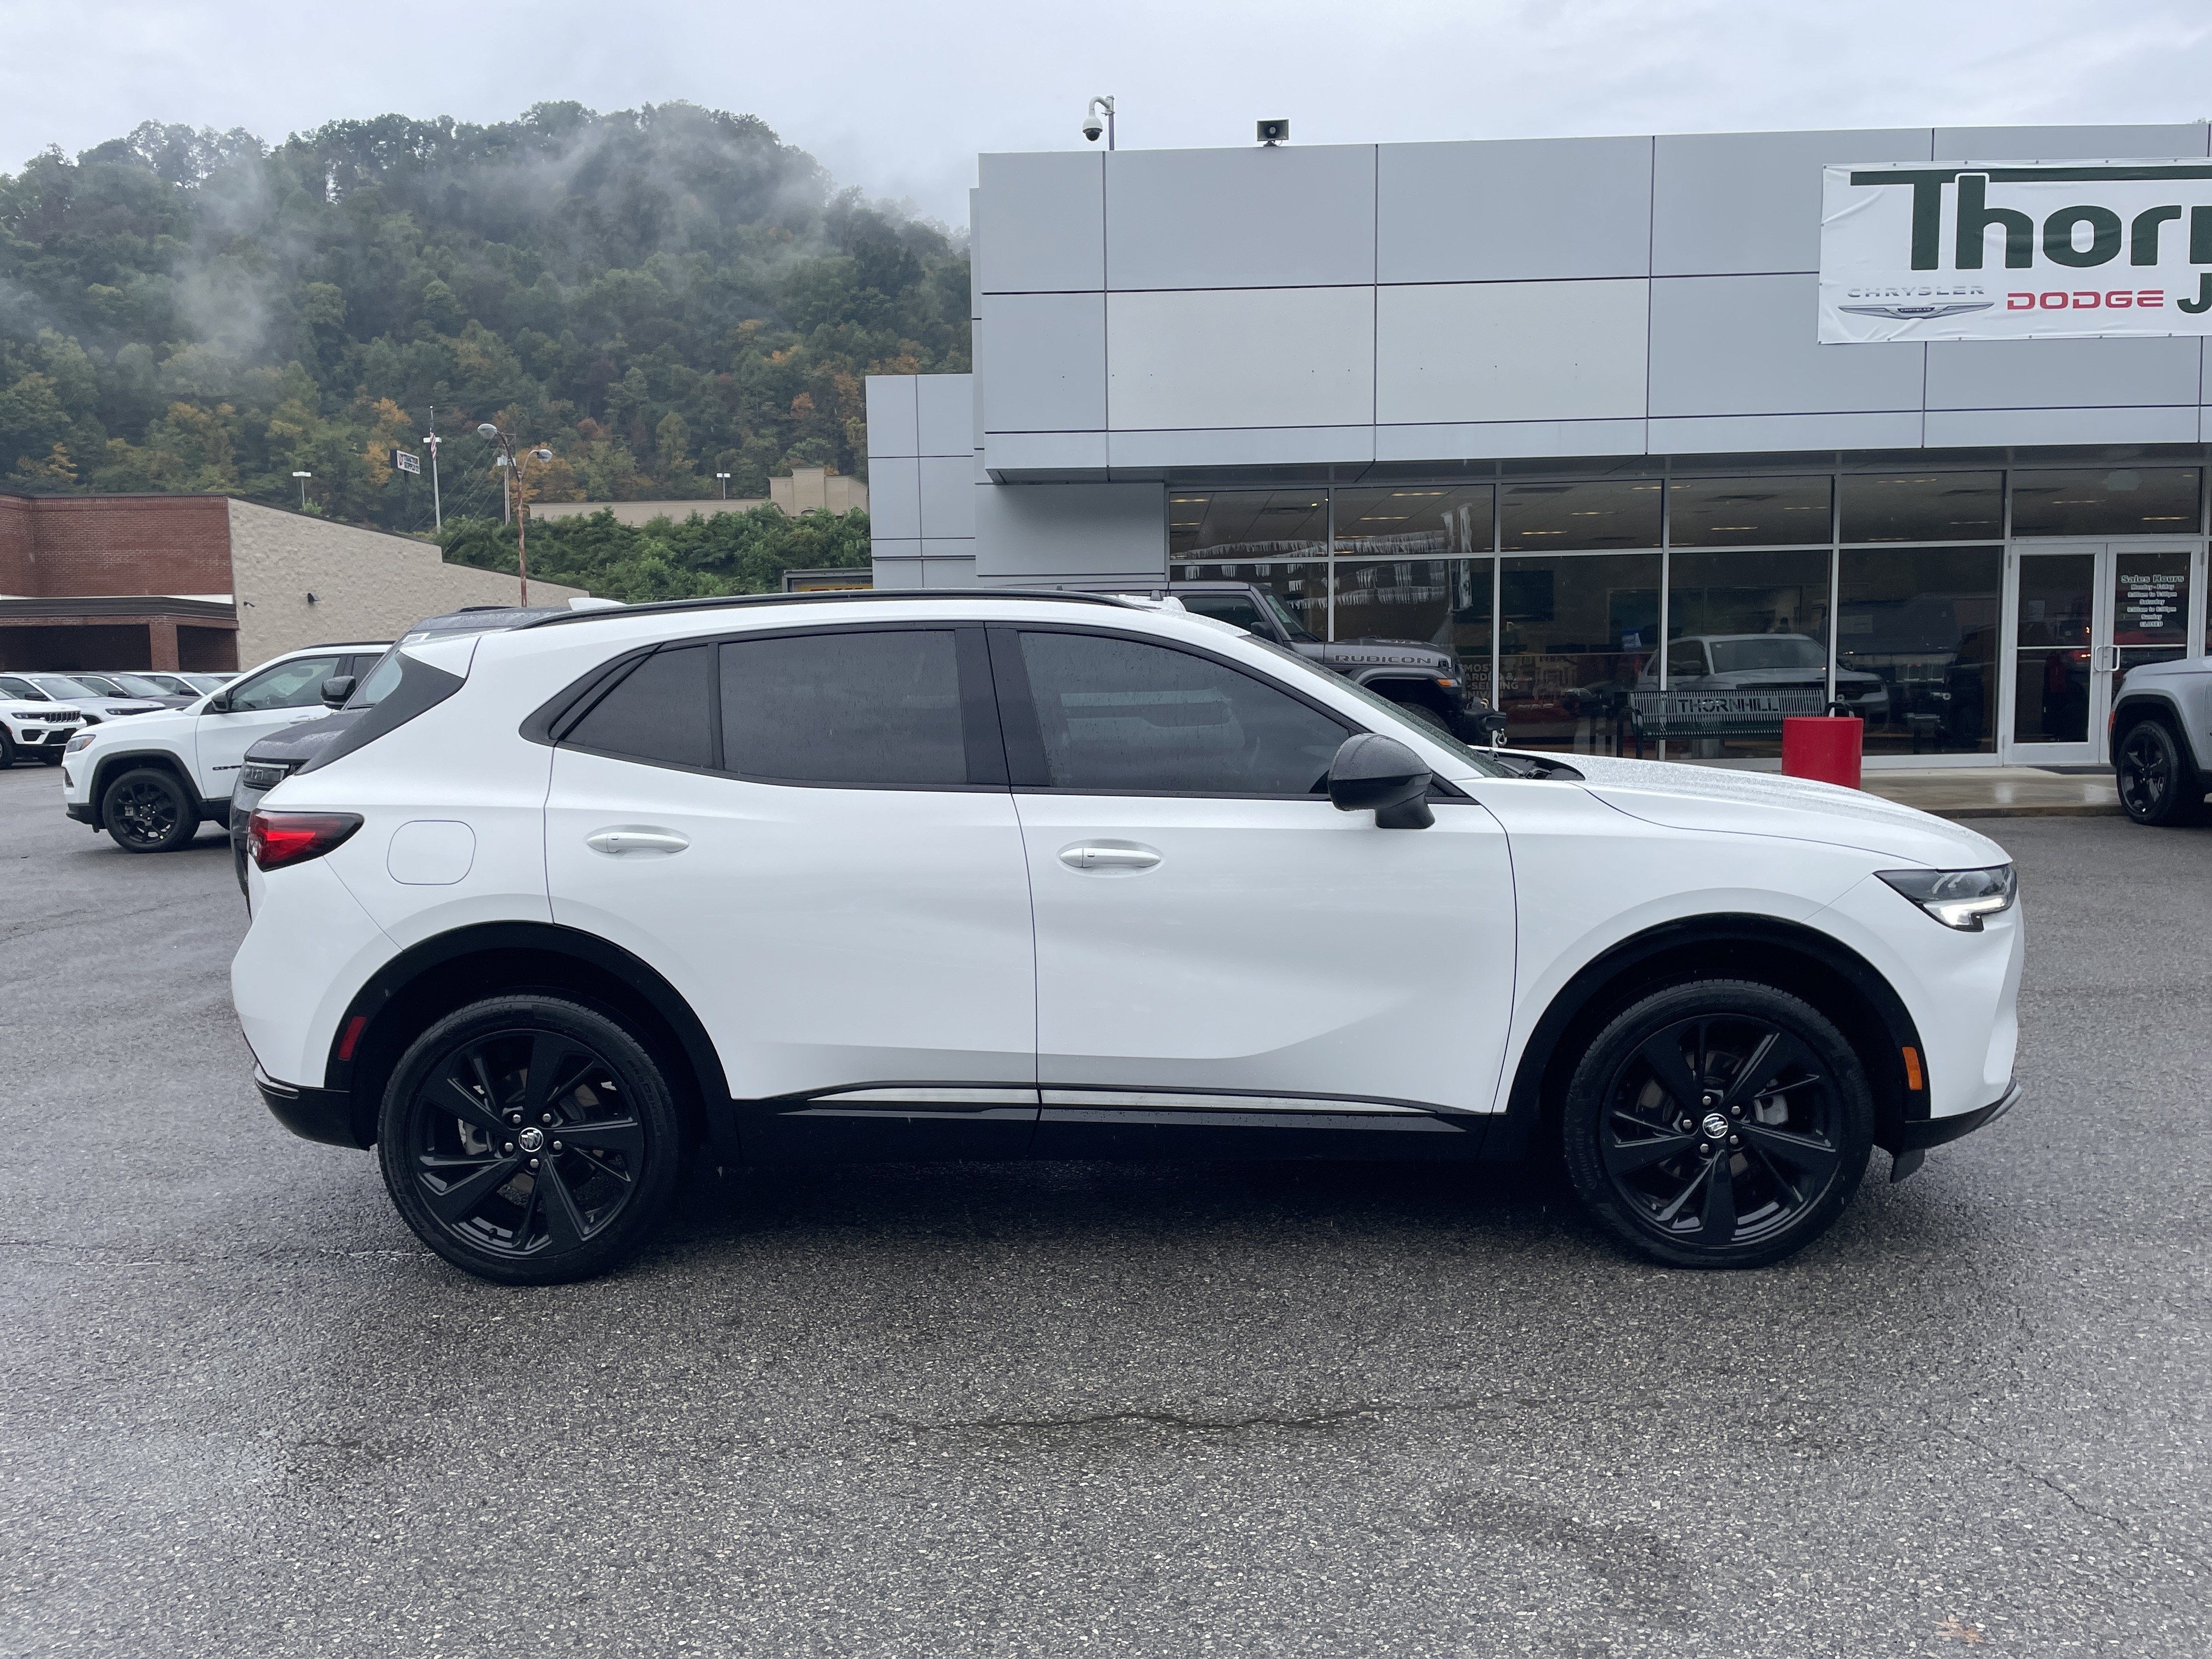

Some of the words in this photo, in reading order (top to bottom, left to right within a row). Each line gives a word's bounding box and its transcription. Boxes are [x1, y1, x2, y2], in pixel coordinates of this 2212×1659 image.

[1850, 165, 2212, 270] Thor
[1847, 286, 1985, 298] CHRYSLER
[2007, 290, 2164, 310] DODGE
[2121, 575, 2151, 584] Sales
[2153, 574, 2185, 583] Hours
[1335, 654, 1432, 664] RUBICON
[1677, 698, 1779, 713] THORNHILL
